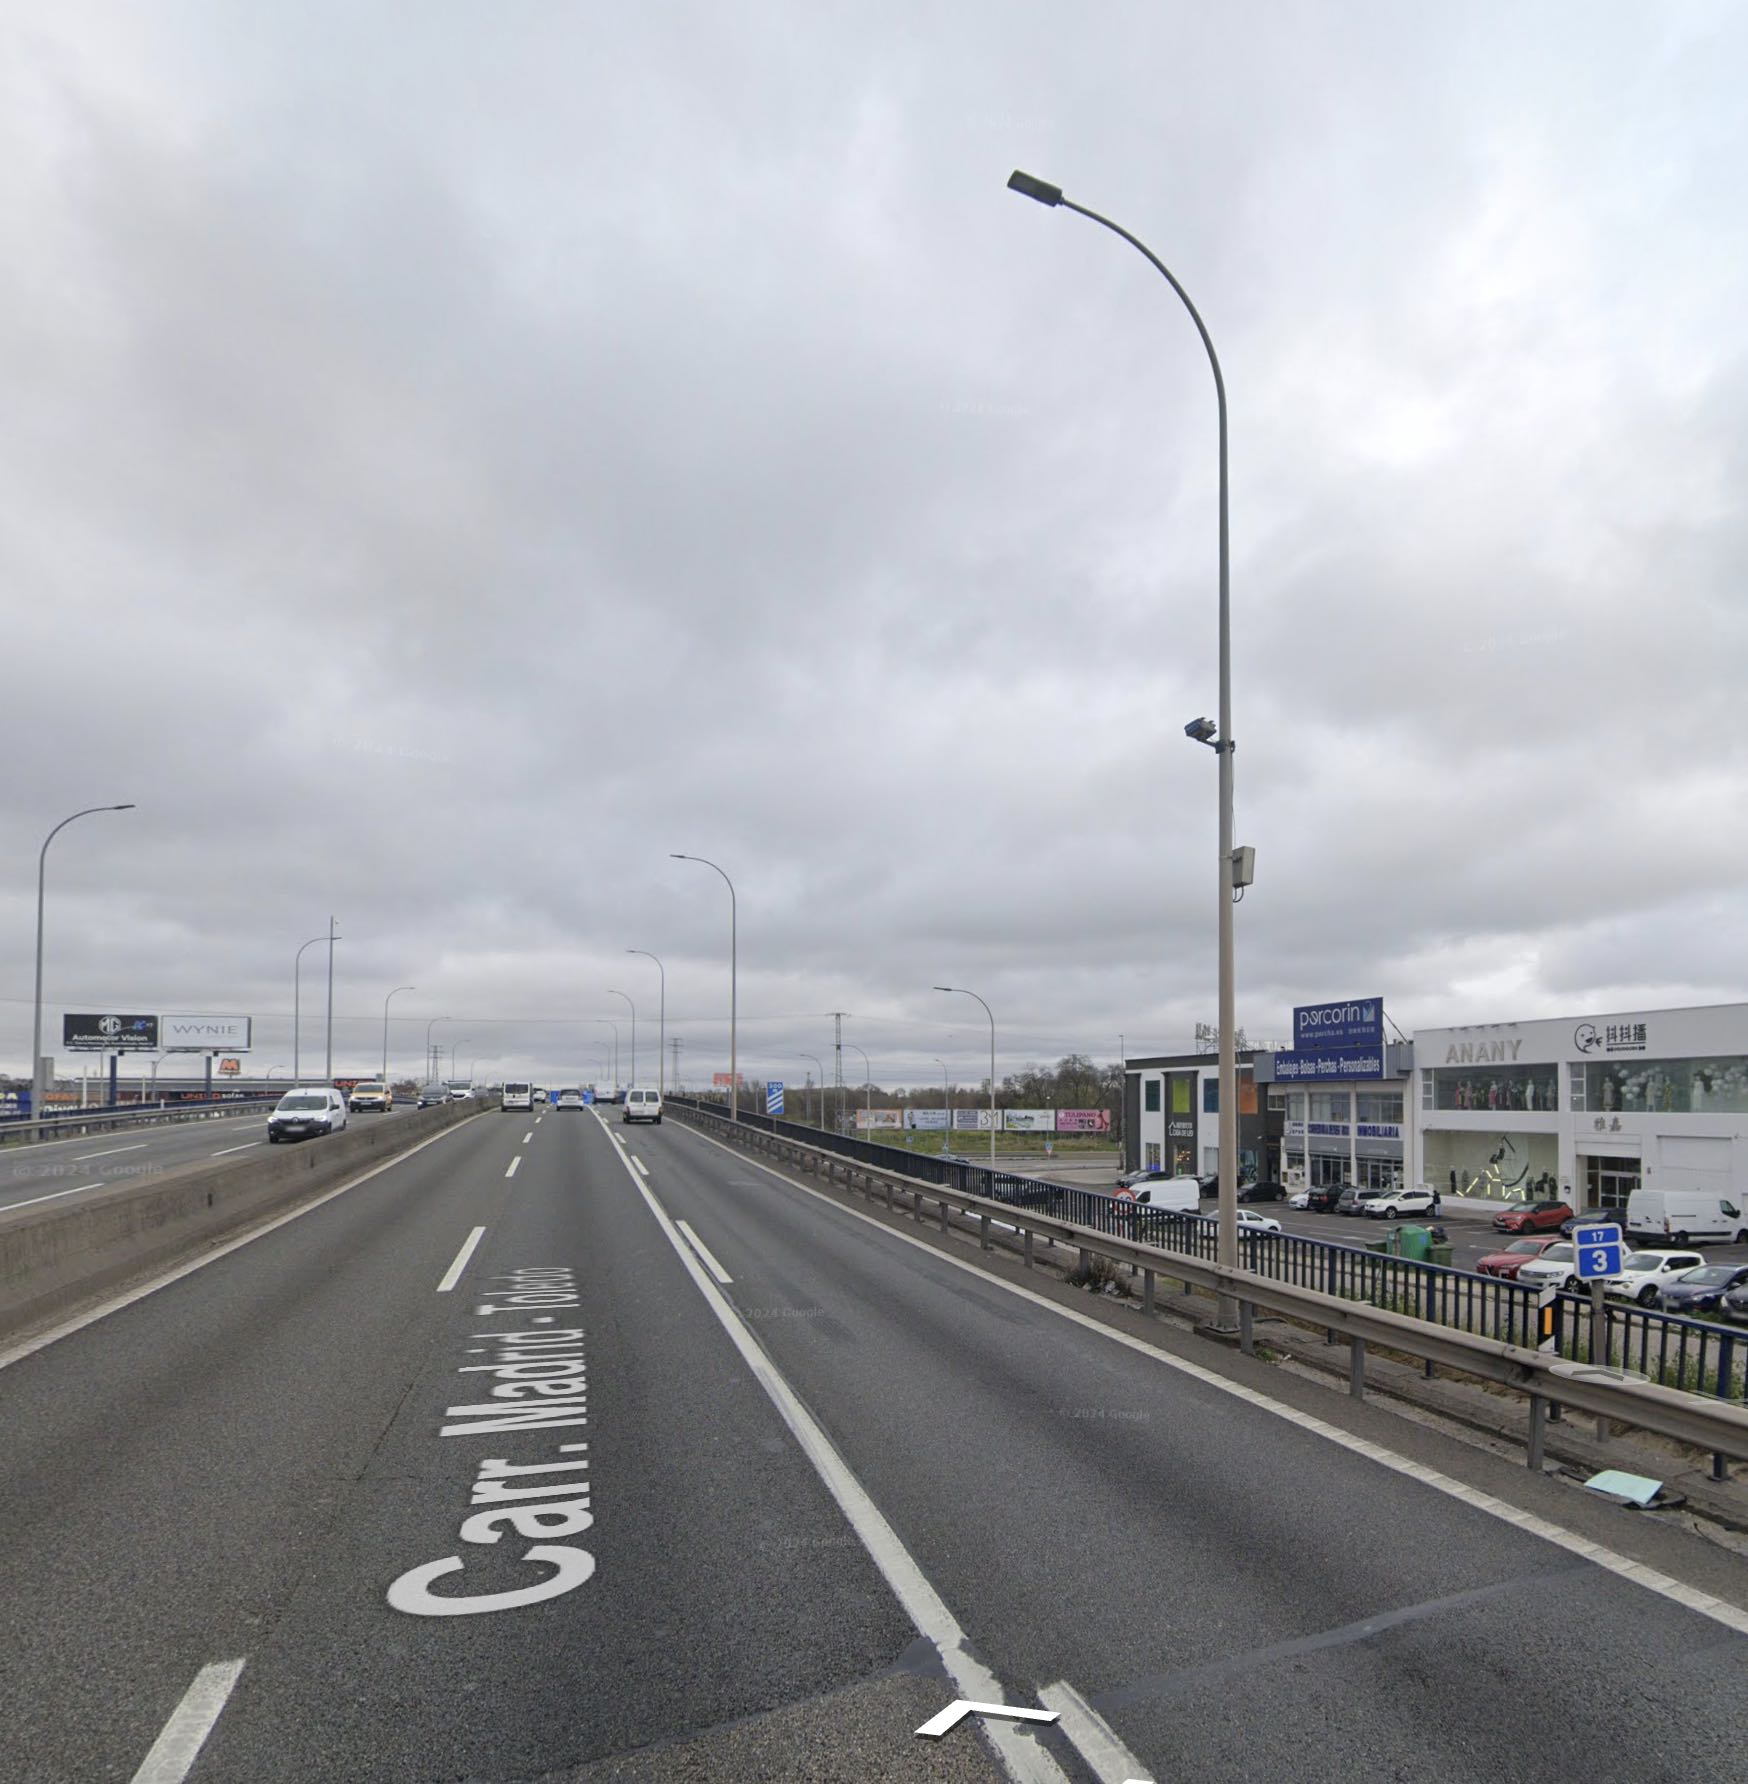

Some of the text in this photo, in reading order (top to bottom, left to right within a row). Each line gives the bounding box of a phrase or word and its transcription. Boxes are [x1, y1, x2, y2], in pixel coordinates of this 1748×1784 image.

[101, 1018, 119, 1033] MG
[173, 1025, 238, 1035] WYNIE
[1446, 1039, 1522, 1064] ANANY
[1592, 1231, 1604, 1242] 17
[1592, 1249, 1608, 1272] 3
